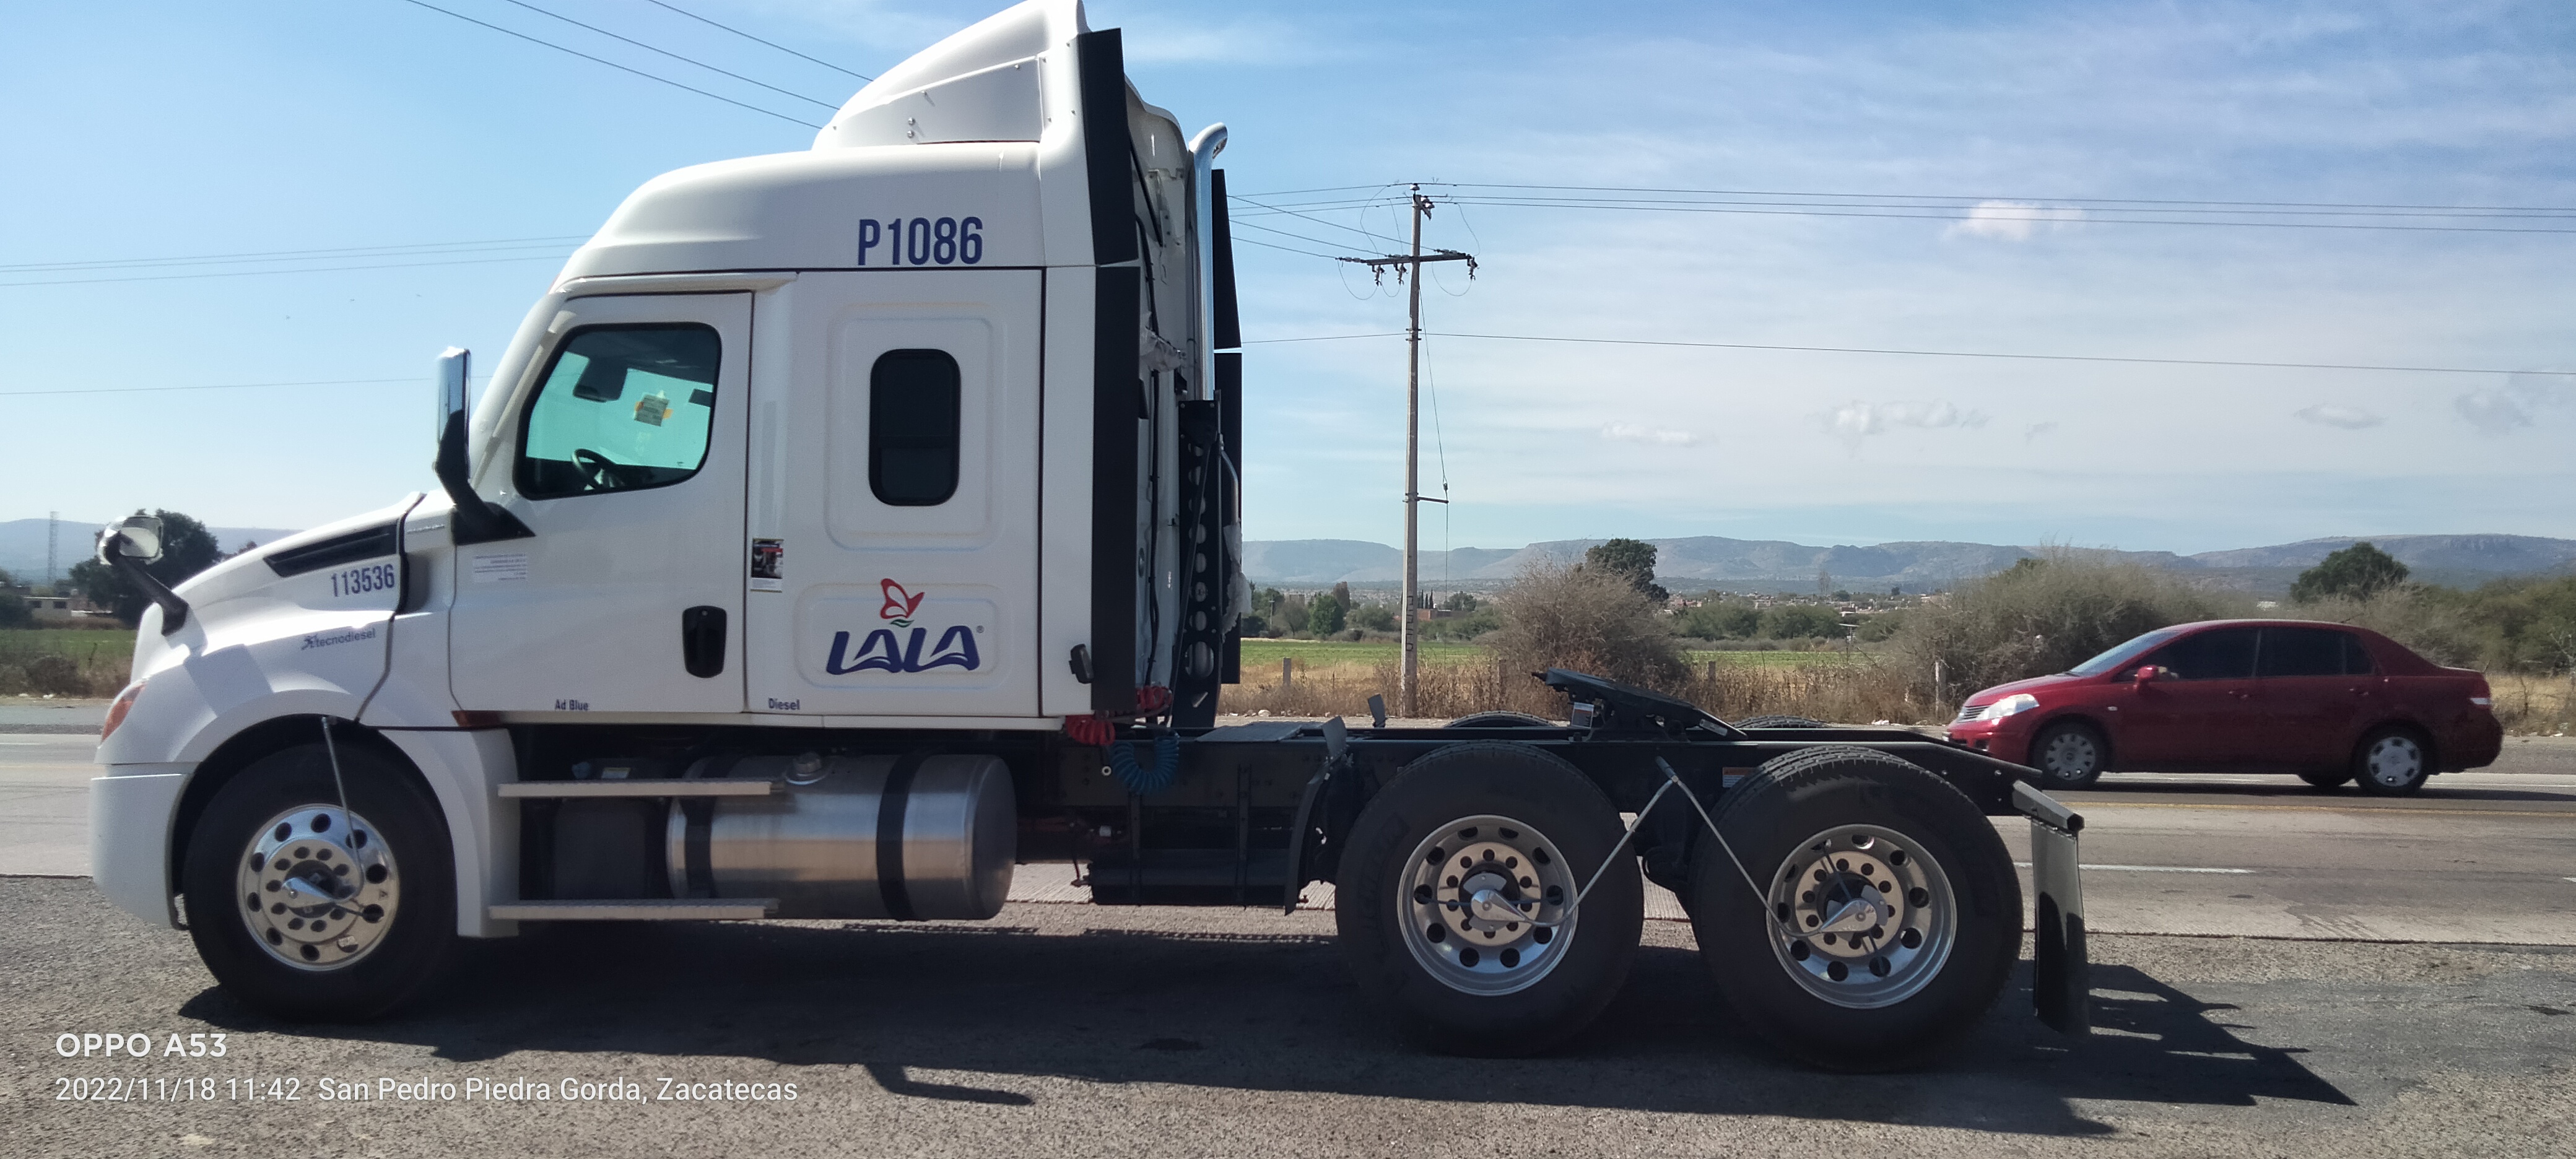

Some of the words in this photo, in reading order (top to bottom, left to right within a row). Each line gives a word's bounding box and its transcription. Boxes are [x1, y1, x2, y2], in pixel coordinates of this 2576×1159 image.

[858, 217, 983, 266] P1086
[331, 563, 395, 597] 113536
[316, 628, 376, 648] tecnodiesel
[826, 625, 980, 675] LALA
[555, 699, 567, 710] Ad
[569, 700, 589, 711] Blue
[768, 698, 800, 710] Diesel
